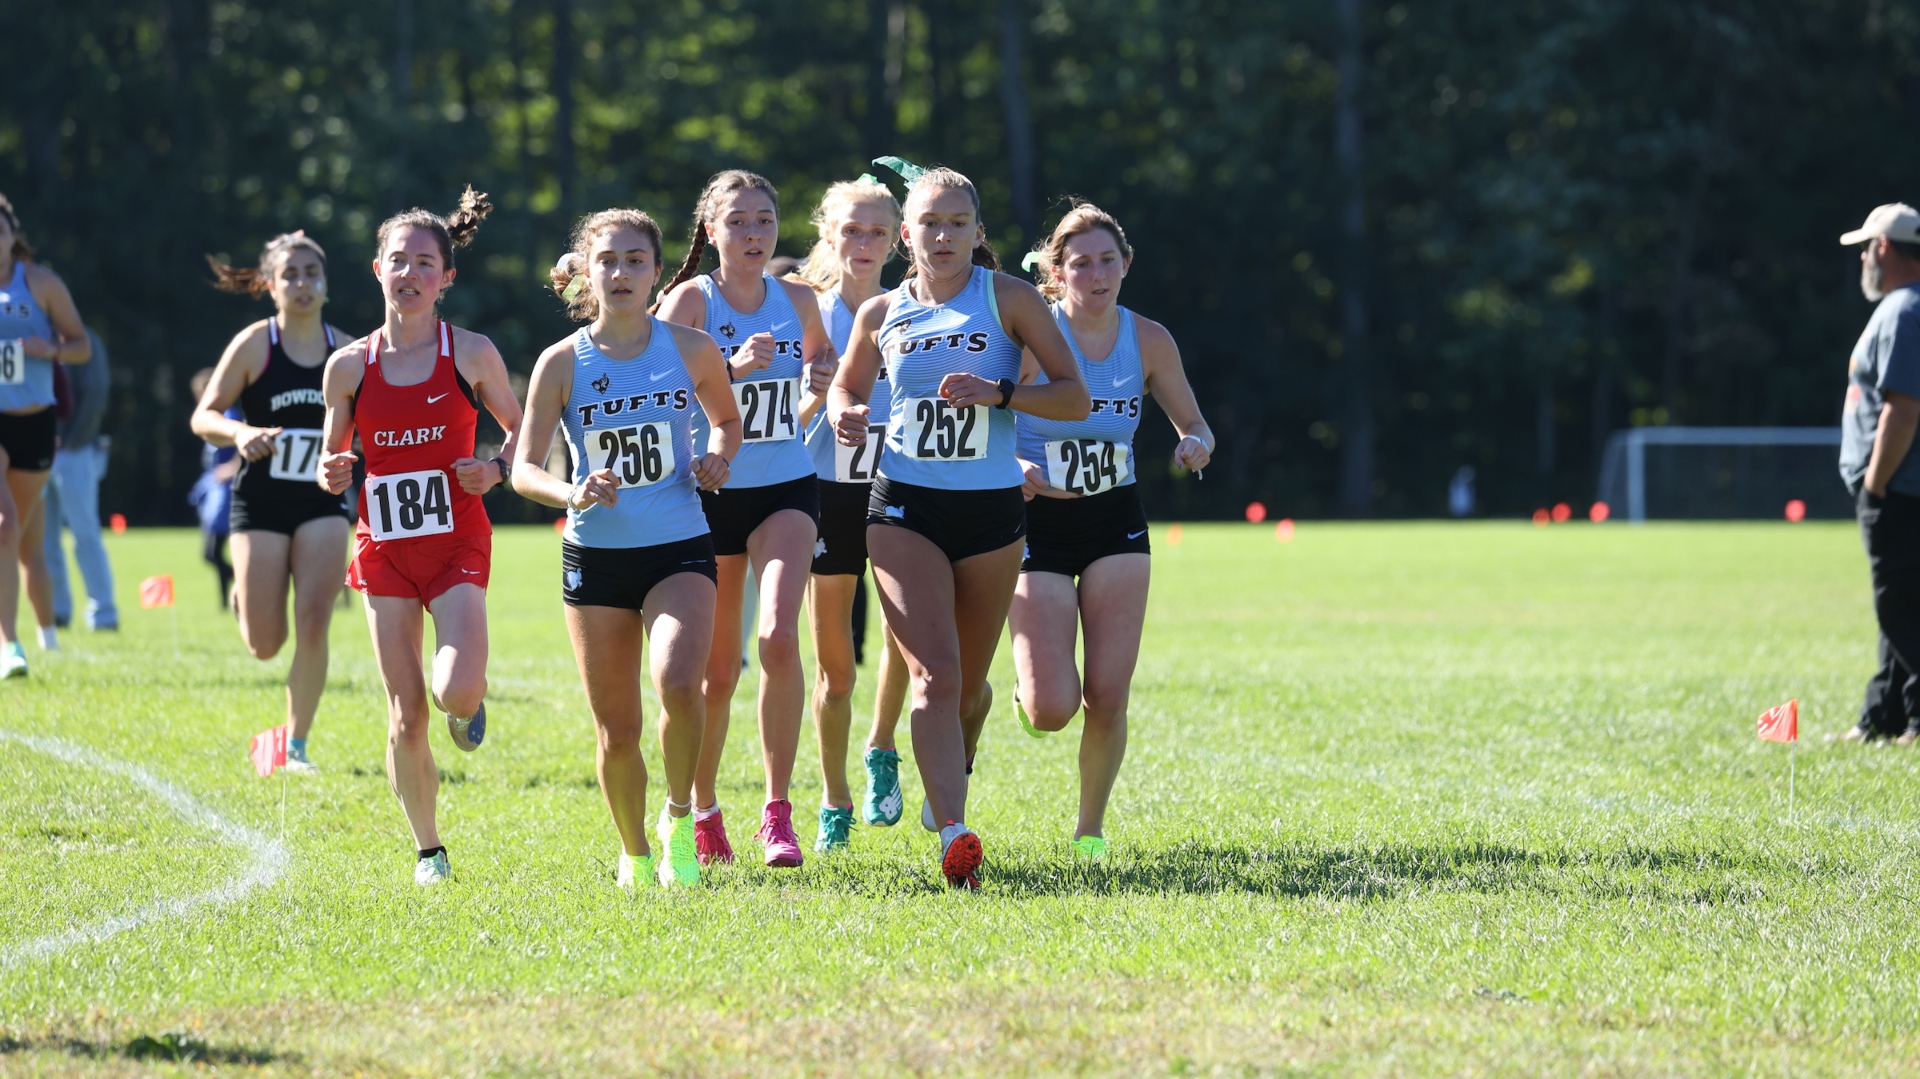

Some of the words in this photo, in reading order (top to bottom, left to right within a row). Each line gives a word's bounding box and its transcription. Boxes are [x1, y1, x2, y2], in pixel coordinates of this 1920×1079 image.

[883, 331, 989, 366] TUFTS
[373, 425, 447, 447] CLARK
[577, 388, 689, 428] TUFTS
[741, 380, 795, 440] 274
[916, 399, 977, 459] 252
[280, 435, 324, 474] 17
[599, 424, 663, 486] 256
[849, 424, 887, 480] 27
[1060, 439, 1118, 495] 254
[373, 475, 450, 533] 184
